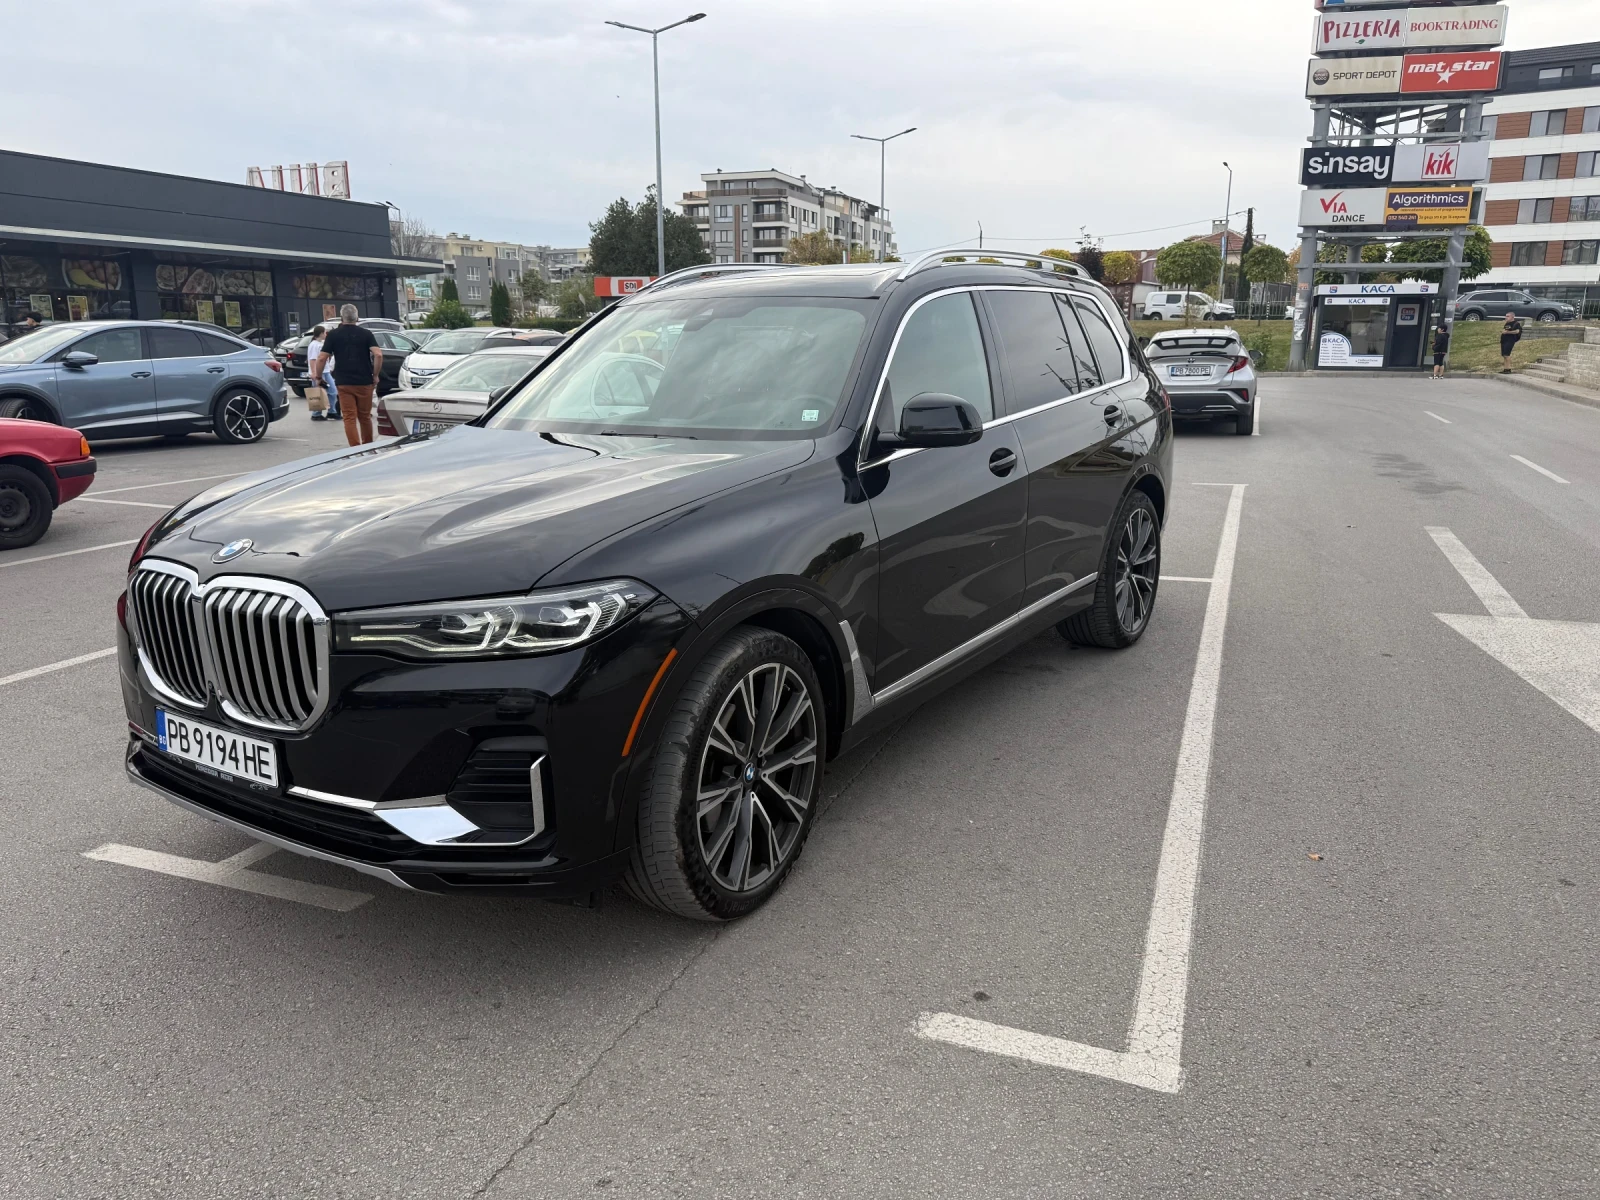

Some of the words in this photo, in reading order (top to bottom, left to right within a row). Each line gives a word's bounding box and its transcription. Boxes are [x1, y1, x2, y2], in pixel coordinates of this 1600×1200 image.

[1323, 18, 1400, 43] PIZZERIA
[1410, 19, 1498, 32] BOOKTRADING
[1407, 61, 1444, 73] mat
[1451, 60, 1495, 72] star
[1333, 72, 1364, 80] SPORT
[1366, 70, 1397, 79] DEPOT
[1392, 194, 1464, 206] Algorithmics
[1332, 214, 1365, 222] DANCE
[1361, 285, 1395, 293] КАСА
[158, 734, 166, 745] BG
